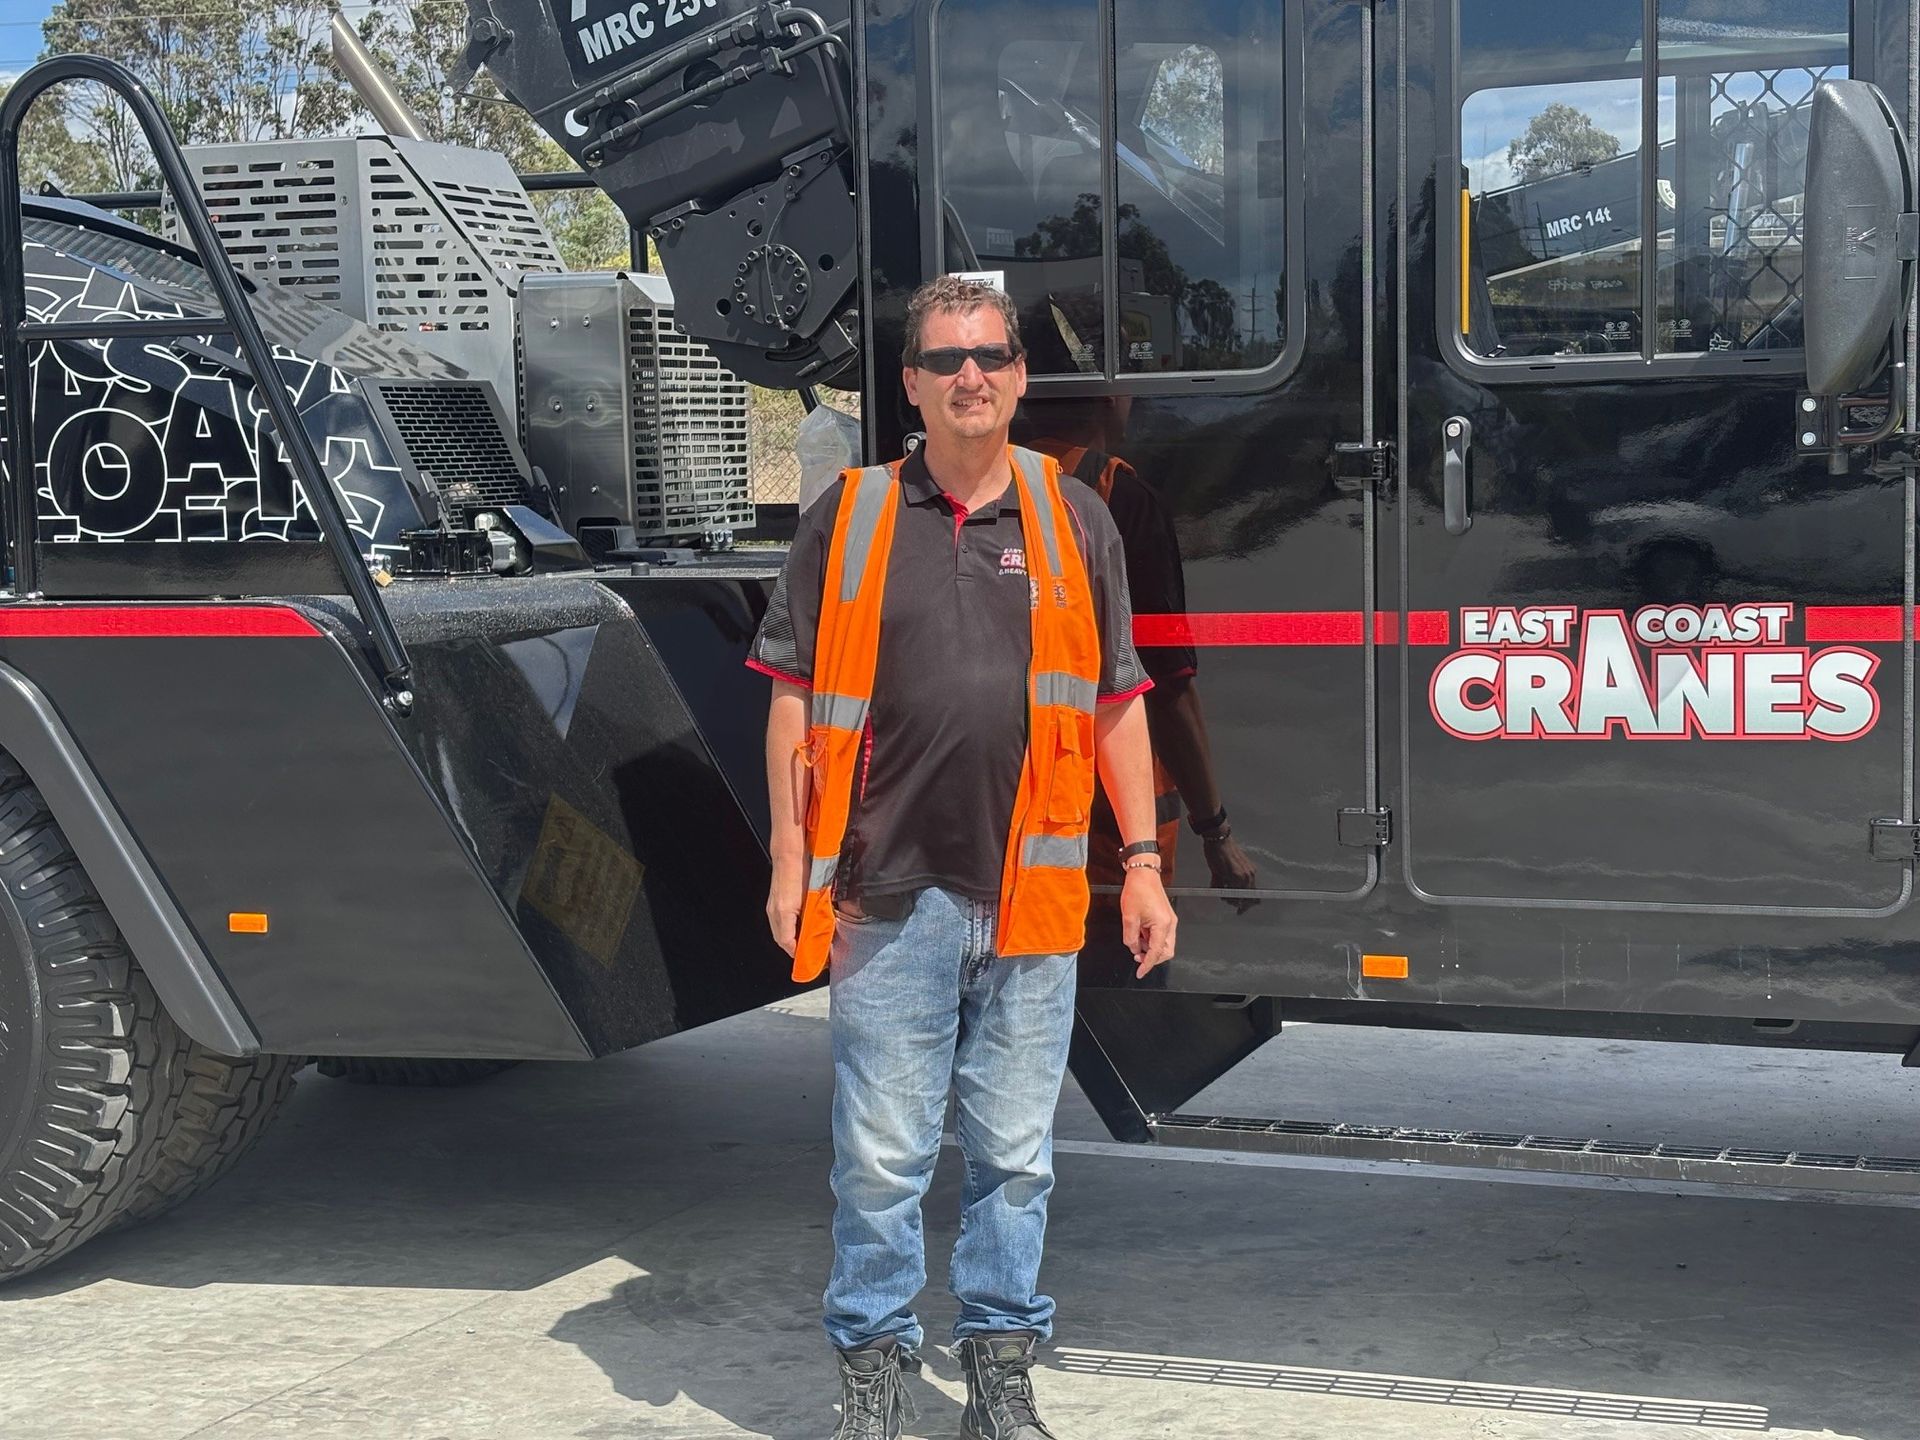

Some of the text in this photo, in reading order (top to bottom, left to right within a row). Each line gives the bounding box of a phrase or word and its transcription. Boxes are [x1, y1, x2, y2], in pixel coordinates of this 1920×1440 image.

[578, 2, 655, 65] MRC
[657, 0, 718, 28] 25
[1546, 206, 1612, 238] MRC 14t
[1461, 605, 1793, 647] EAST COAST
[1430, 609, 1880, 740] CRANES
